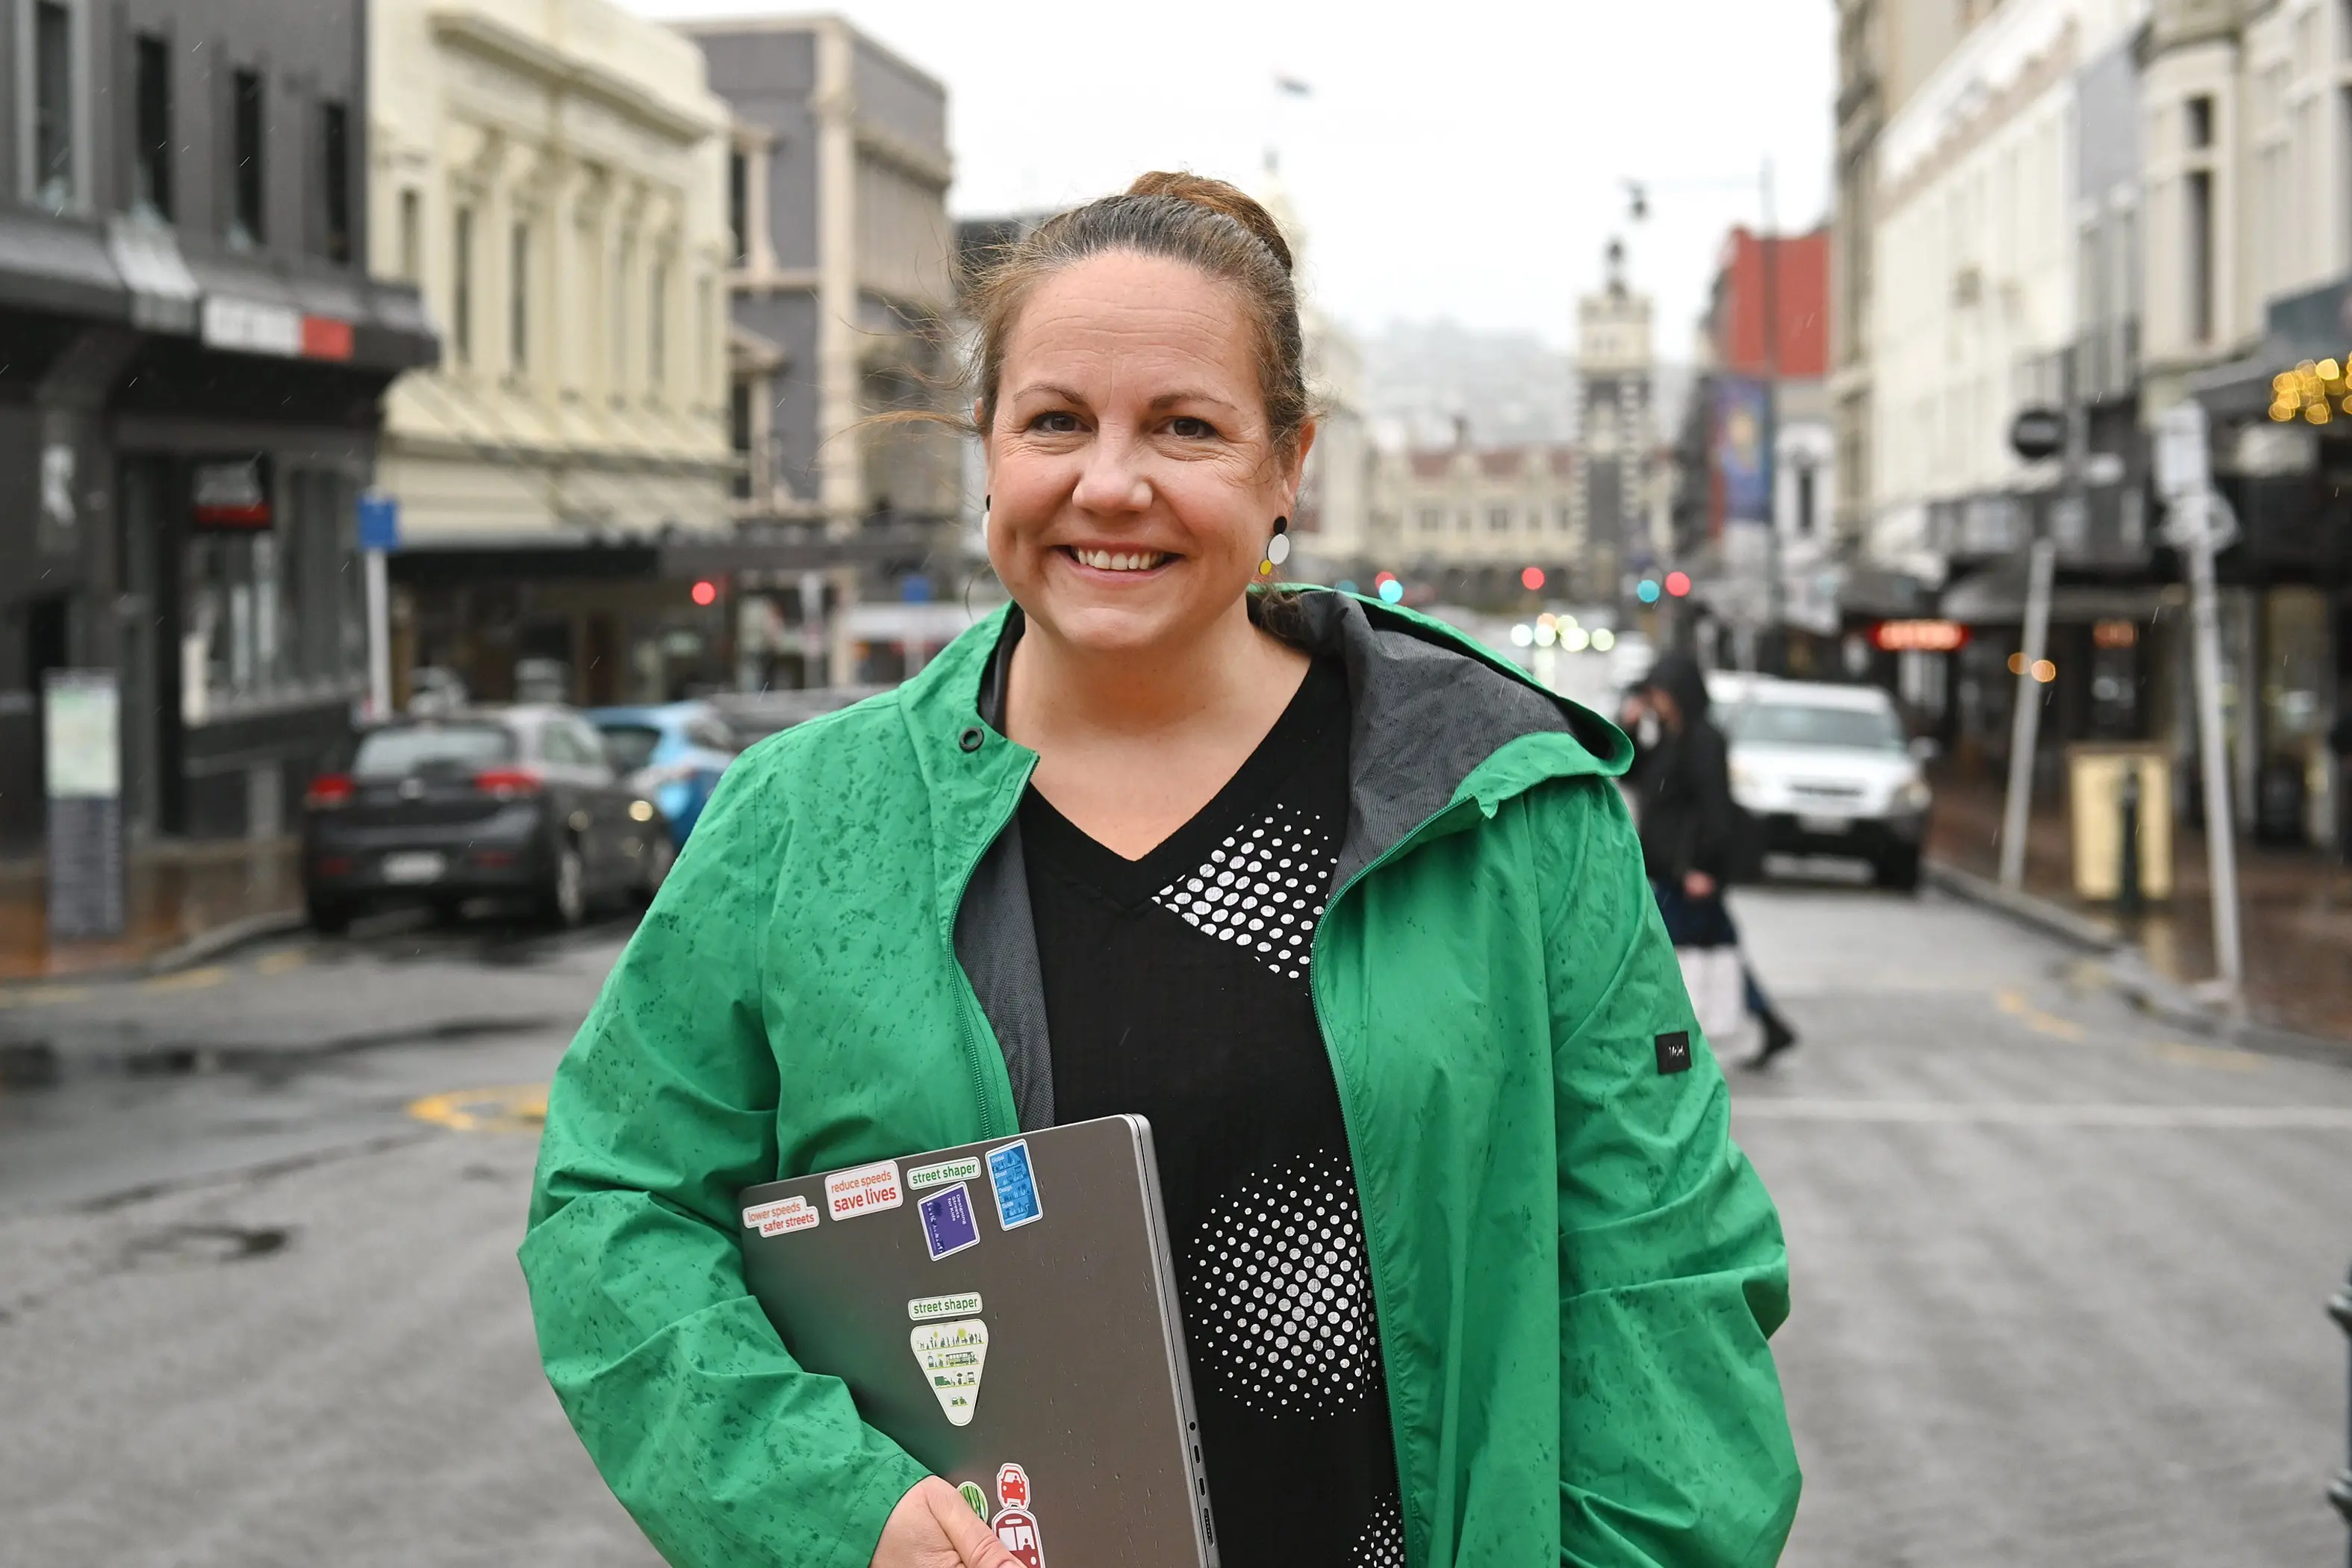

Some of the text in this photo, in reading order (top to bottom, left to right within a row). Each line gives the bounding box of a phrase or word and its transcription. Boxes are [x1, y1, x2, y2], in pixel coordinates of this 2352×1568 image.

[992, 1154, 1005, 1163] Global
[831, 1170, 892, 1193] reduce speeds
[912, 1164, 975, 1183] street shaper
[834, 1186, 896, 1212] save lives
[951, 1195, 959, 1219] Streets
[956, 1194, 967, 1225] Designing
[747, 1201, 801, 1222] lower speeds
[763, 1213, 815, 1232] safer streets
[914, 1298, 977, 1314] street shaper
